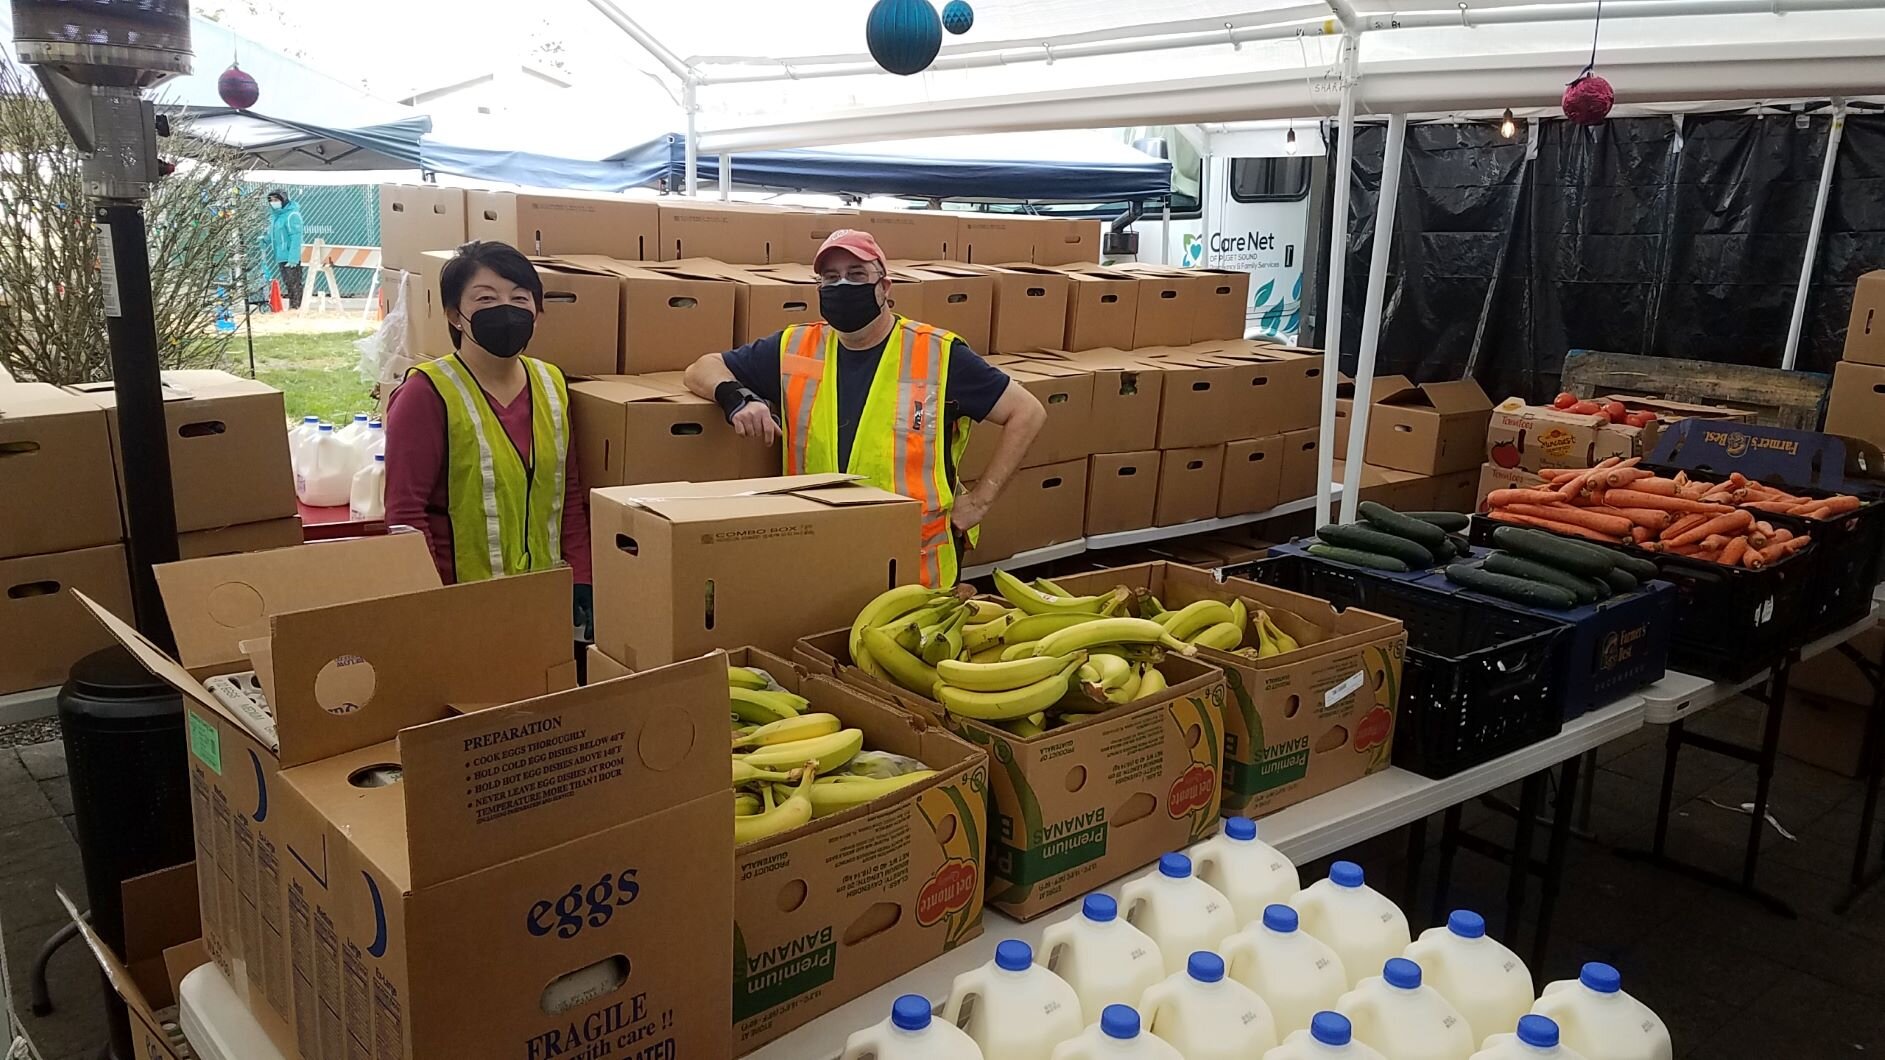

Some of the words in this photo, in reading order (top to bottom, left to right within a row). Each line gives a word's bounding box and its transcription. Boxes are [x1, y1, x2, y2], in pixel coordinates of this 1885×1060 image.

[1210, 232, 1246, 253] Care
[1247, 231, 1275, 251] Net
[1238, 253, 1258, 261] SOUND
[1704, 431, 1729, 447] Best
[1750, 436, 1799, 456] Farmer's
[715, 528, 767, 538] COMBO
[463, 715, 562, 751] PREPARATION
[473, 752, 500, 767] COOK
[501, 746, 526, 760] EGGS
[527, 729, 587, 752] THOROUGHLY
[474, 766, 500, 780] HOLD
[501, 758, 527, 772] COLD
[528, 753, 547, 766] EGG
[548, 745, 578, 760] DISHES
[579, 736, 609, 751] BELOW
[475, 779, 501, 794] HOLD
[502, 773, 522, 786] HOT
[523, 767, 542, 780] EGG
[543, 759, 573, 774] DISHES
[574, 750, 602, 765] ABOVE
[1261, 753, 1306, 776] Premium
[475, 791, 507, 808] NEVER
[507, 783, 536, 798] LEAVE
[537, 777, 556, 789] EGG
[557, 767, 587, 783] DISHES
[587, 764, 598, 775] AT
[599, 757, 625, 772] ROOM
[476, 793, 542, 818] TEMPERATURE
[542, 785, 569, 799] MORE
[570, 777, 593, 791] THAN
[599, 769, 623, 783] HOUR
[1043, 827, 1104, 859] Premium
[740, 852, 788, 871] GUATEMALA
[740, 871, 752, 881] OF
[753, 859, 791, 877] PRODUCT
[956, 874, 973, 897] Del
[527, 868, 640, 939] eggs
[747, 948, 831, 994] Premium
[525, 992, 648, 1060] FRAGILE
[617, 1022, 656, 1048] care
[661, 1009, 673, 1030] !!
